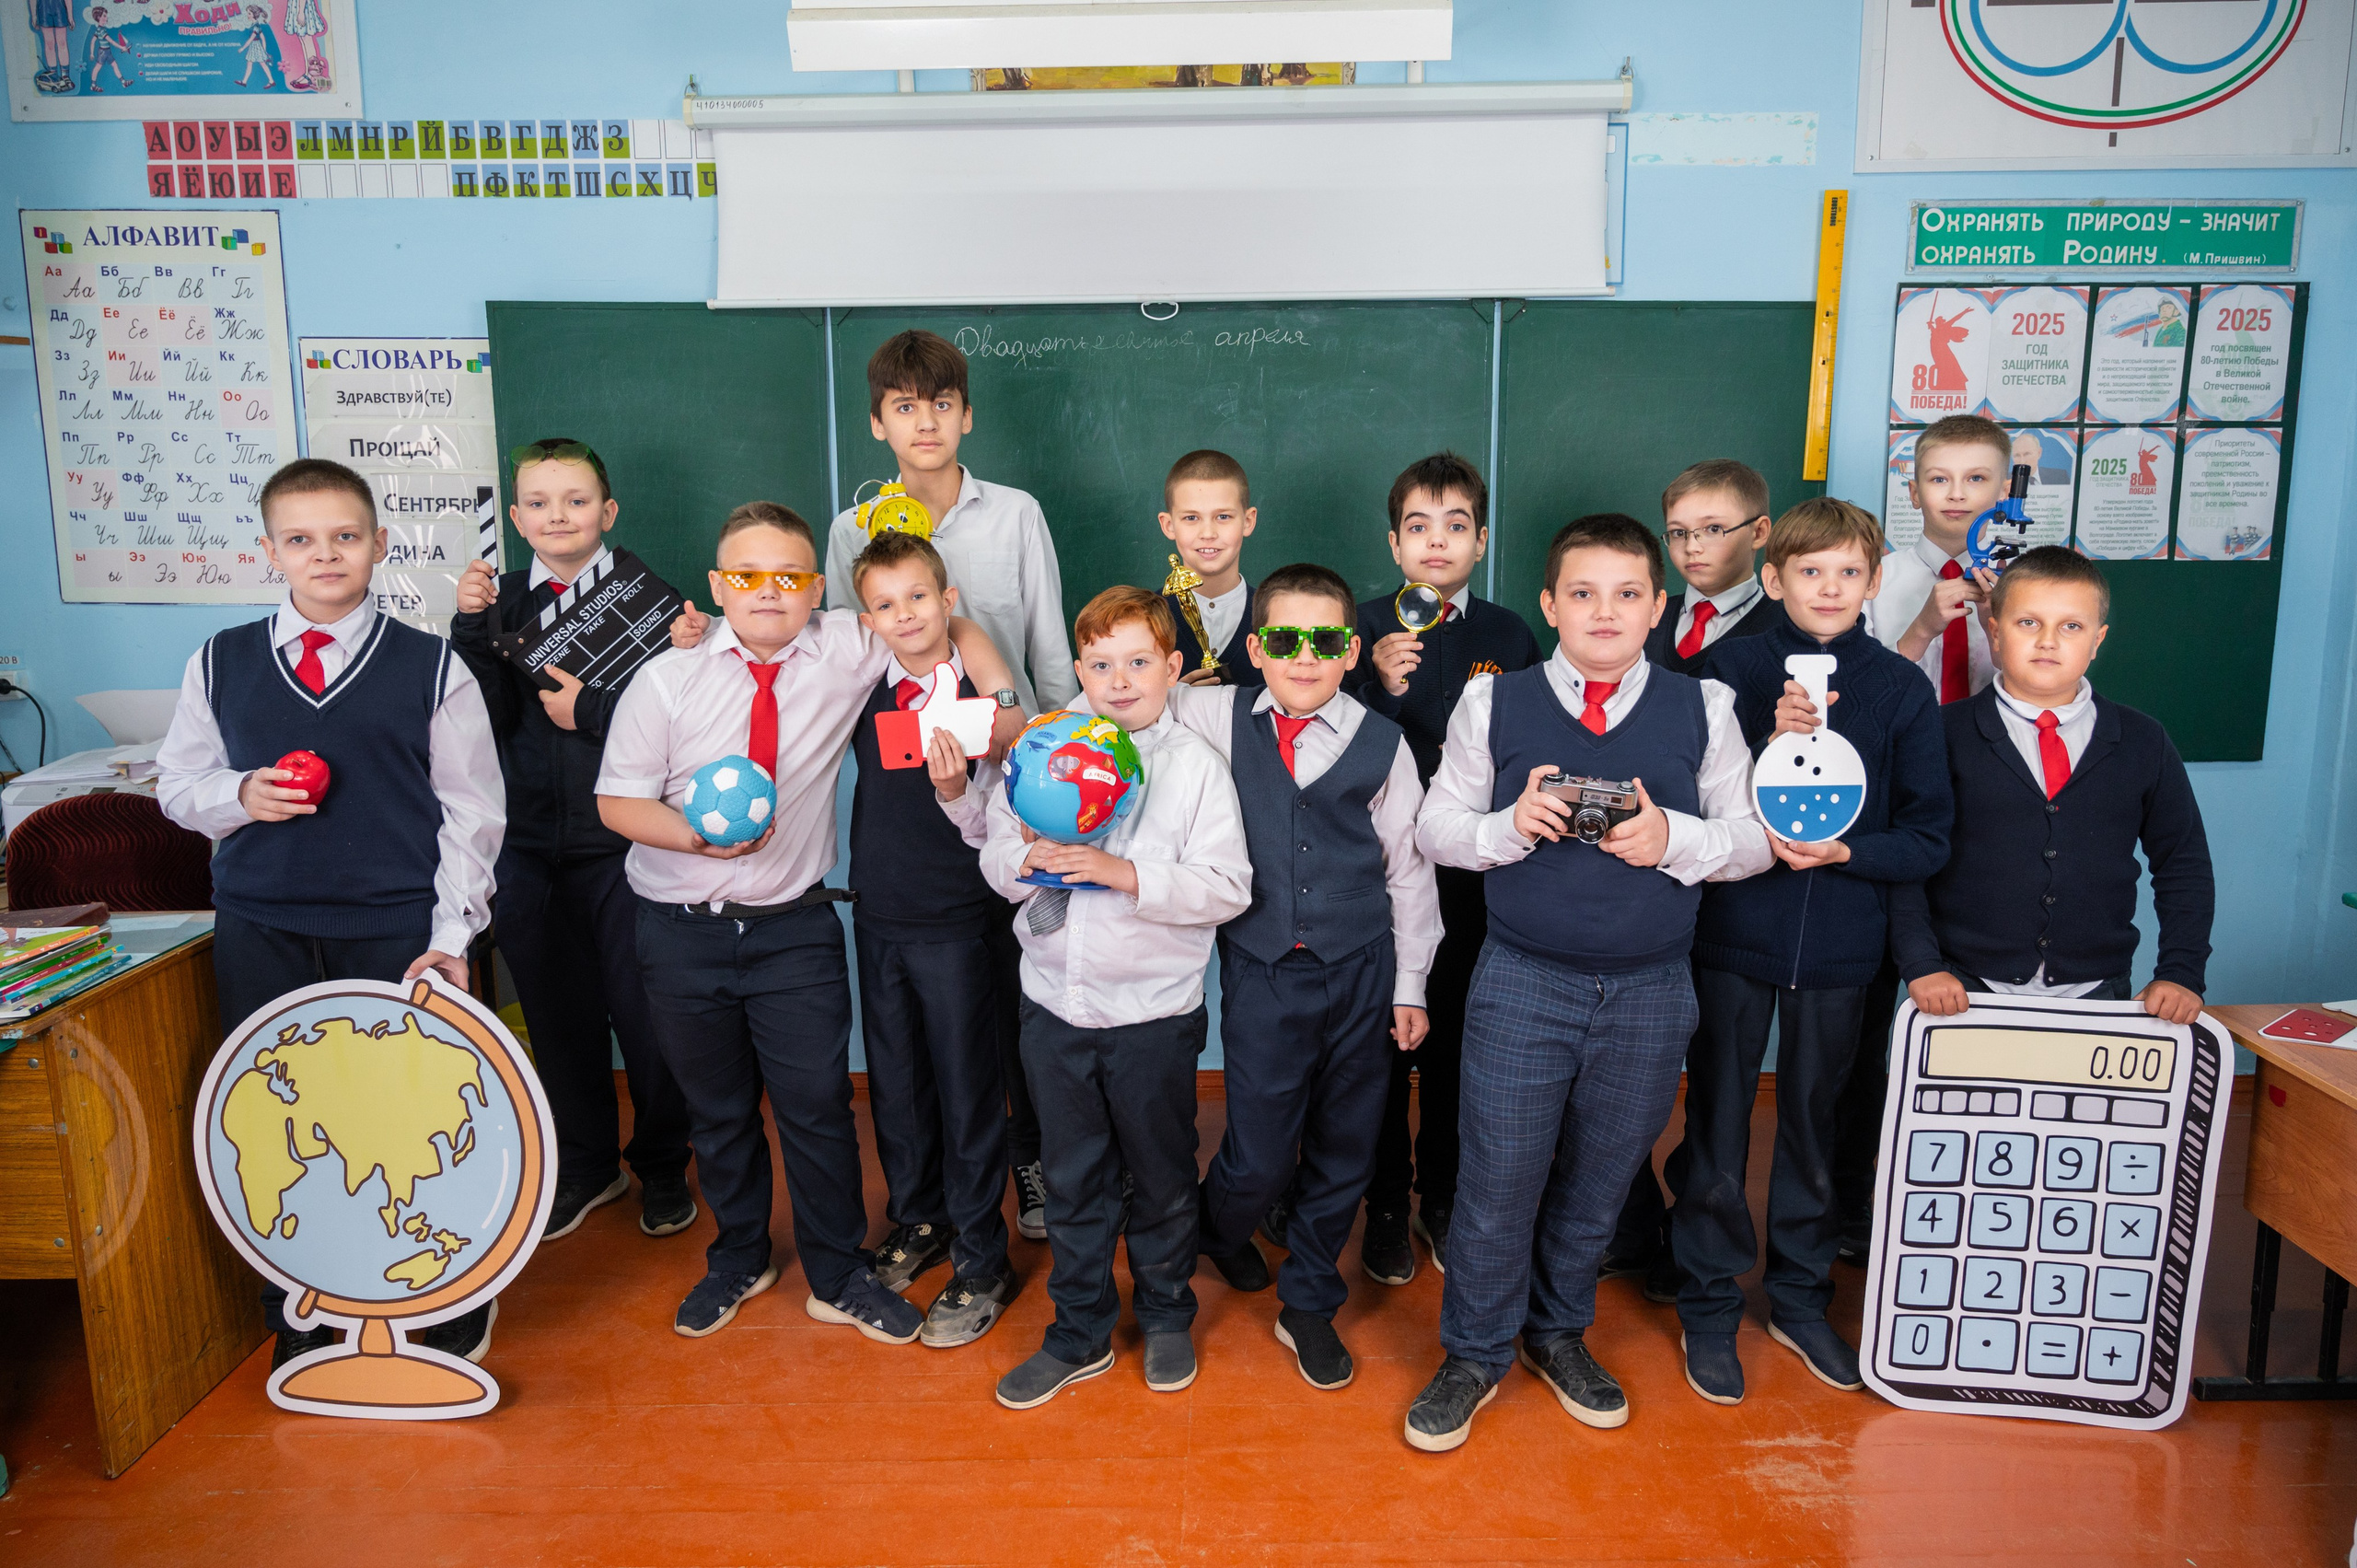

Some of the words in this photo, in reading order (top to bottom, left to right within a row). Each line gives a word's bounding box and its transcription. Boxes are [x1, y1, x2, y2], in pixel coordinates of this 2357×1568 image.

[174, 1, 241, 24] Ходи
[179, 23, 232, 35] ПРАВИЛЬНО!
[2200, 213, 2281, 231] ЗНАЧИТ
[83, 226, 219, 247] АЛФАВИТ
[1922, 246, 2036, 263] ОХРАНЯТЬ
[2012, 313, 2065, 335] 2025
[2216, 308, 2272, 331] 2025
[1214, 326, 1309, 361] апреля
[2026, 344, 2048, 356] ГОД
[2211, 344, 2225, 353] год
[2228, 344, 2271, 353] посвящен
[332, 348, 462, 369] СЛОВАРЬ
[2002, 359, 2069, 371] ЗАЩИТНИКА
[2200, 355, 2242, 365] 80-летию
[2244, 356, 2279, 366] Победы
[1912, 364, 1938, 390] 80
[2002, 375, 2066, 386] ОТЕЧЕСТВА
[2223, 369, 2261, 377] Великой
[2203, 381, 2270, 390] Отечественной
[1910, 395, 1967, 411] ПОБЕДА!
[2221, 395, 2249, 403] войне.
[2214, 439, 2255, 447] Приоритеты
[2194, 449, 2238, 458] современной
[2091, 459, 2127, 475] 2025
[2129, 487, 2156, 495] ПОБЕДА!
[547, 645, 572, 668] CENE
[583, 615, 606, 636] TAKE
[621, 583, 644, 603] ROLL
[633, 610, 662, 638] SOUND
[525, 618, 583, 668] UNIVERSAL
[2090, 1045, 2161, 1082] 0.00
[1929, 1143, 1946, 1172] 7
[1988, 1141, 2013, 1176] 8
[2057, 1146, 2083, 1180] 9
[1918, 1198, 1943, 1233] 4
[1988, 1202, 2013, 1232] 5
[2052, 1206, 2078, 1237] 6
[1920, 1268, 1927, 1294] 1
[1983, 1271, 2003, 1299] 2
[2049, 1274, 2067, 1306] 3
[1912, 1323, 1930, 1355] 0
